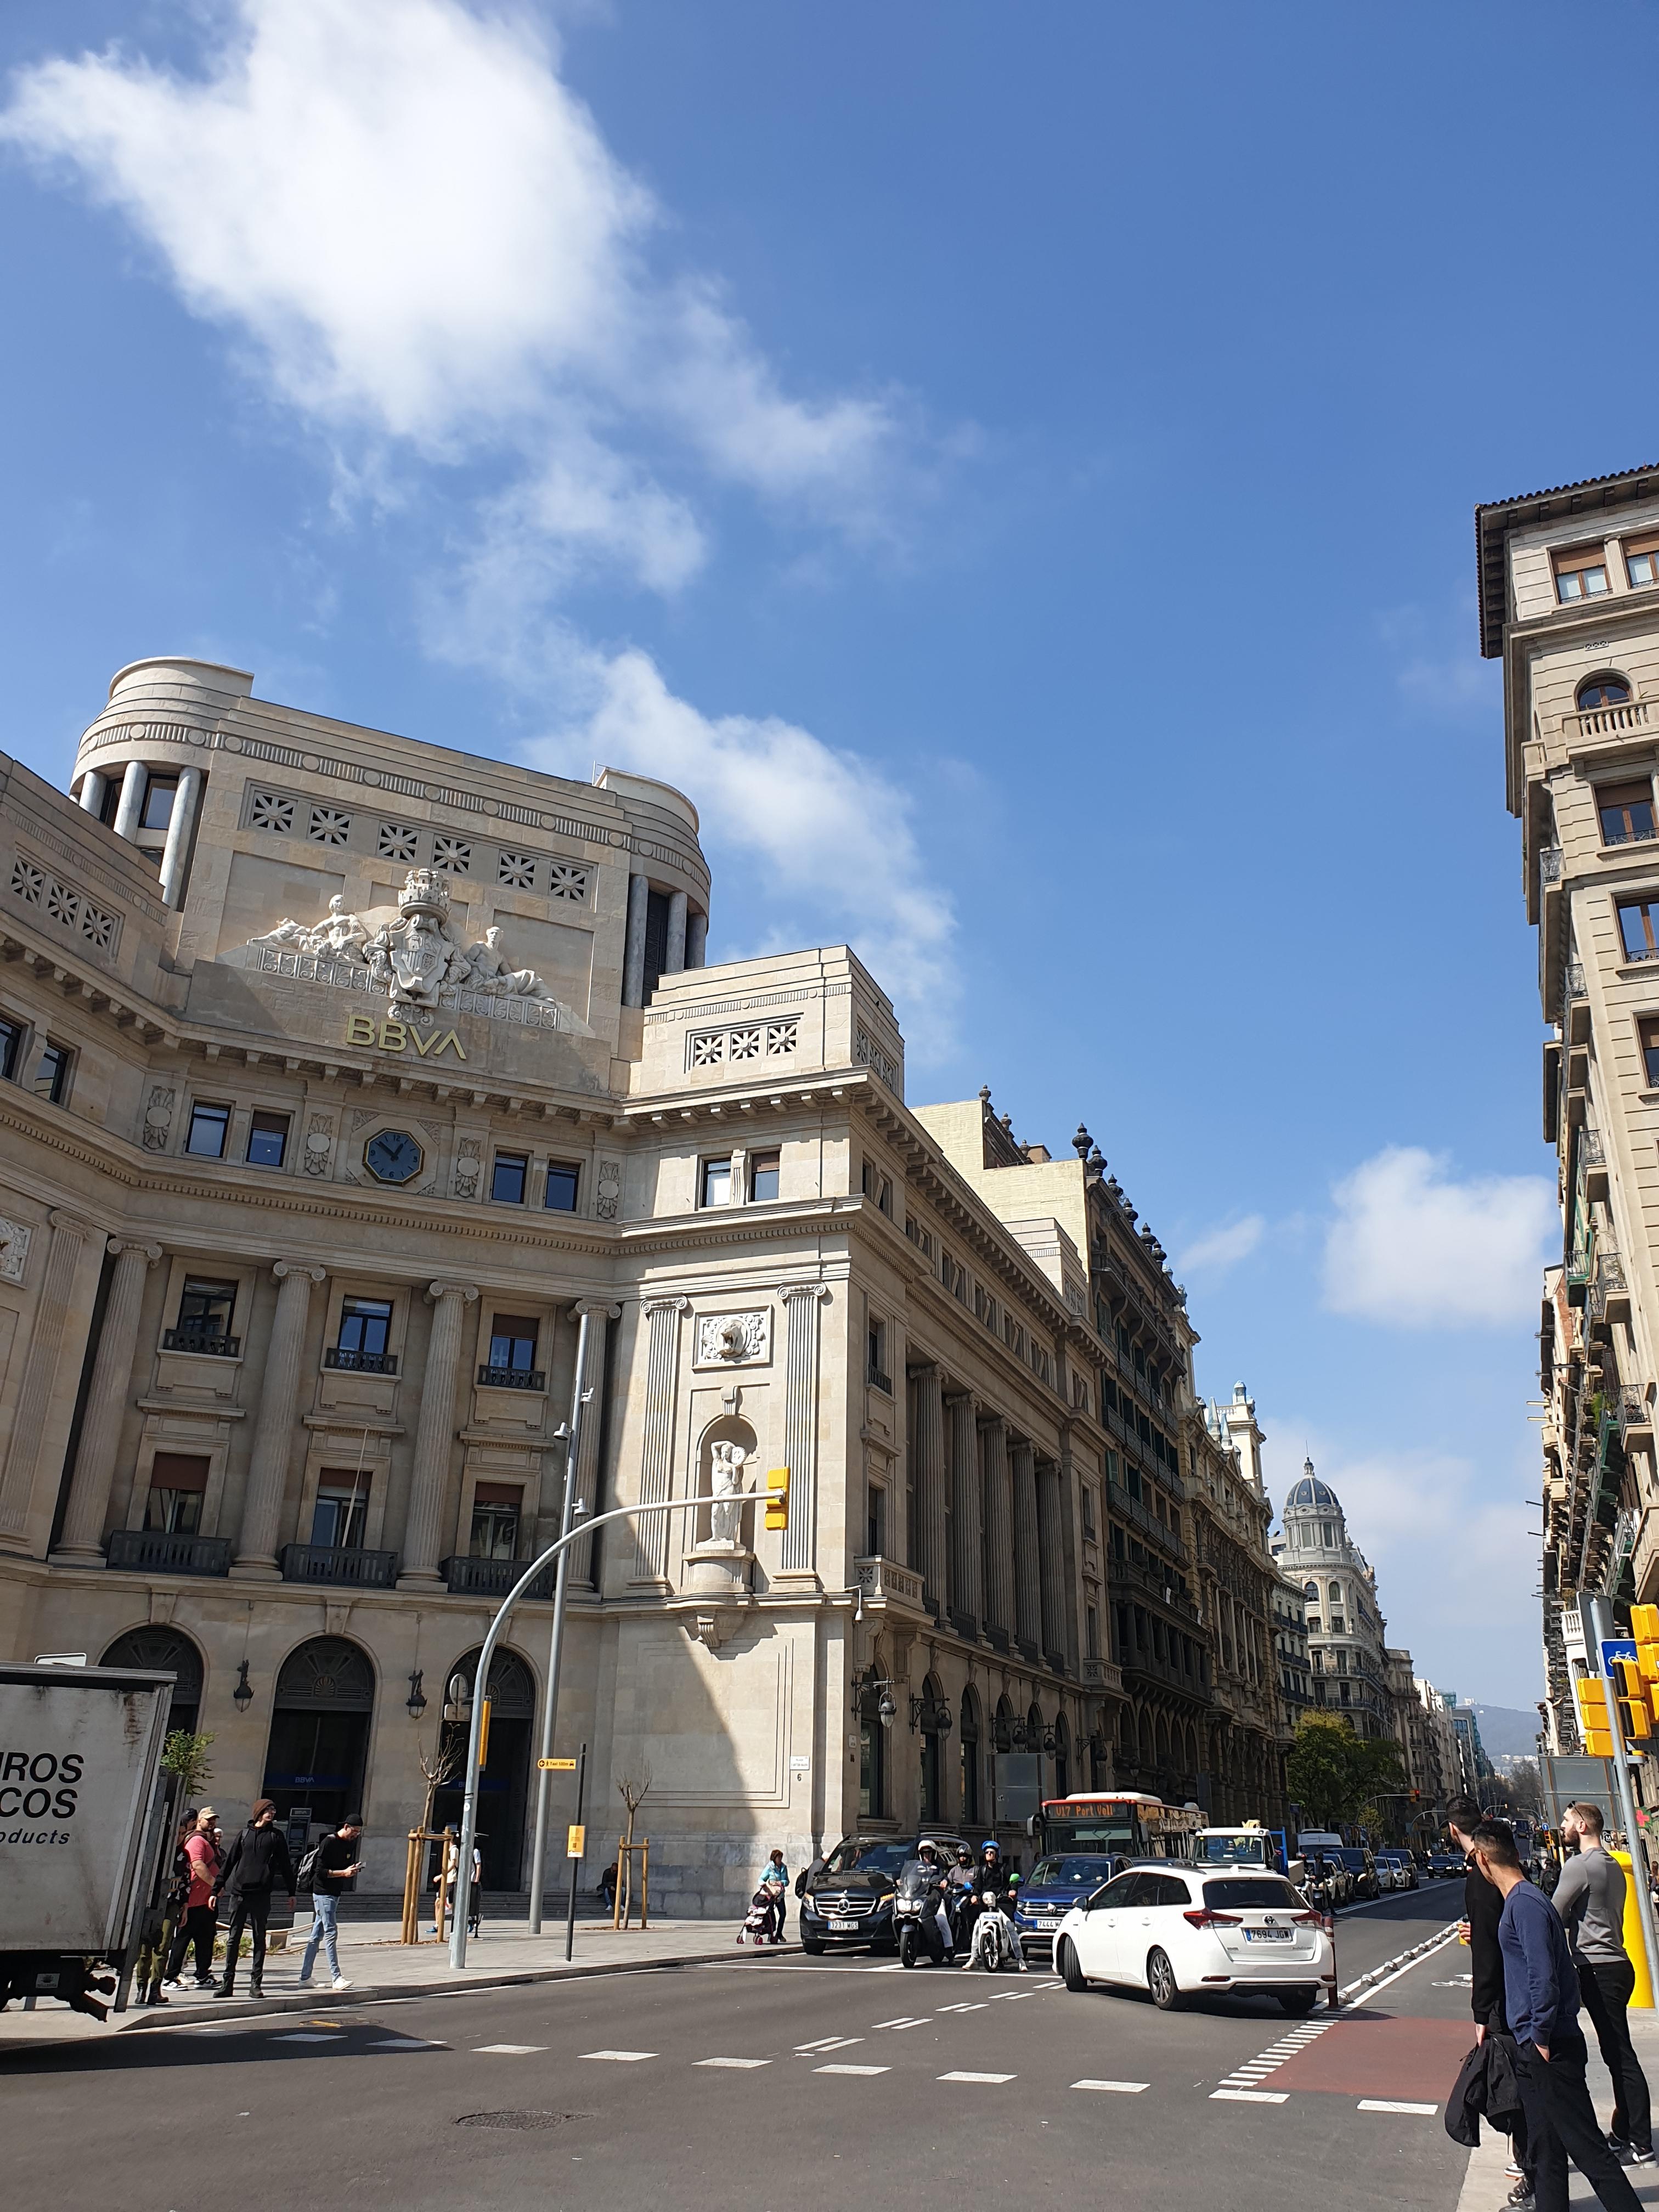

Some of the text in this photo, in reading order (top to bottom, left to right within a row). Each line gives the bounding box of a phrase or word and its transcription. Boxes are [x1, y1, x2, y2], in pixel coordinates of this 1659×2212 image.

[345, 1015, 466, 1060] BBVA
[797, 1773, 802, 1781] 6
[0, 1787, 78, 1819] COS
[1076, 1805, 1094, 1816] Port
[1251, 1930, 1289, 1939] 7694 JGW
